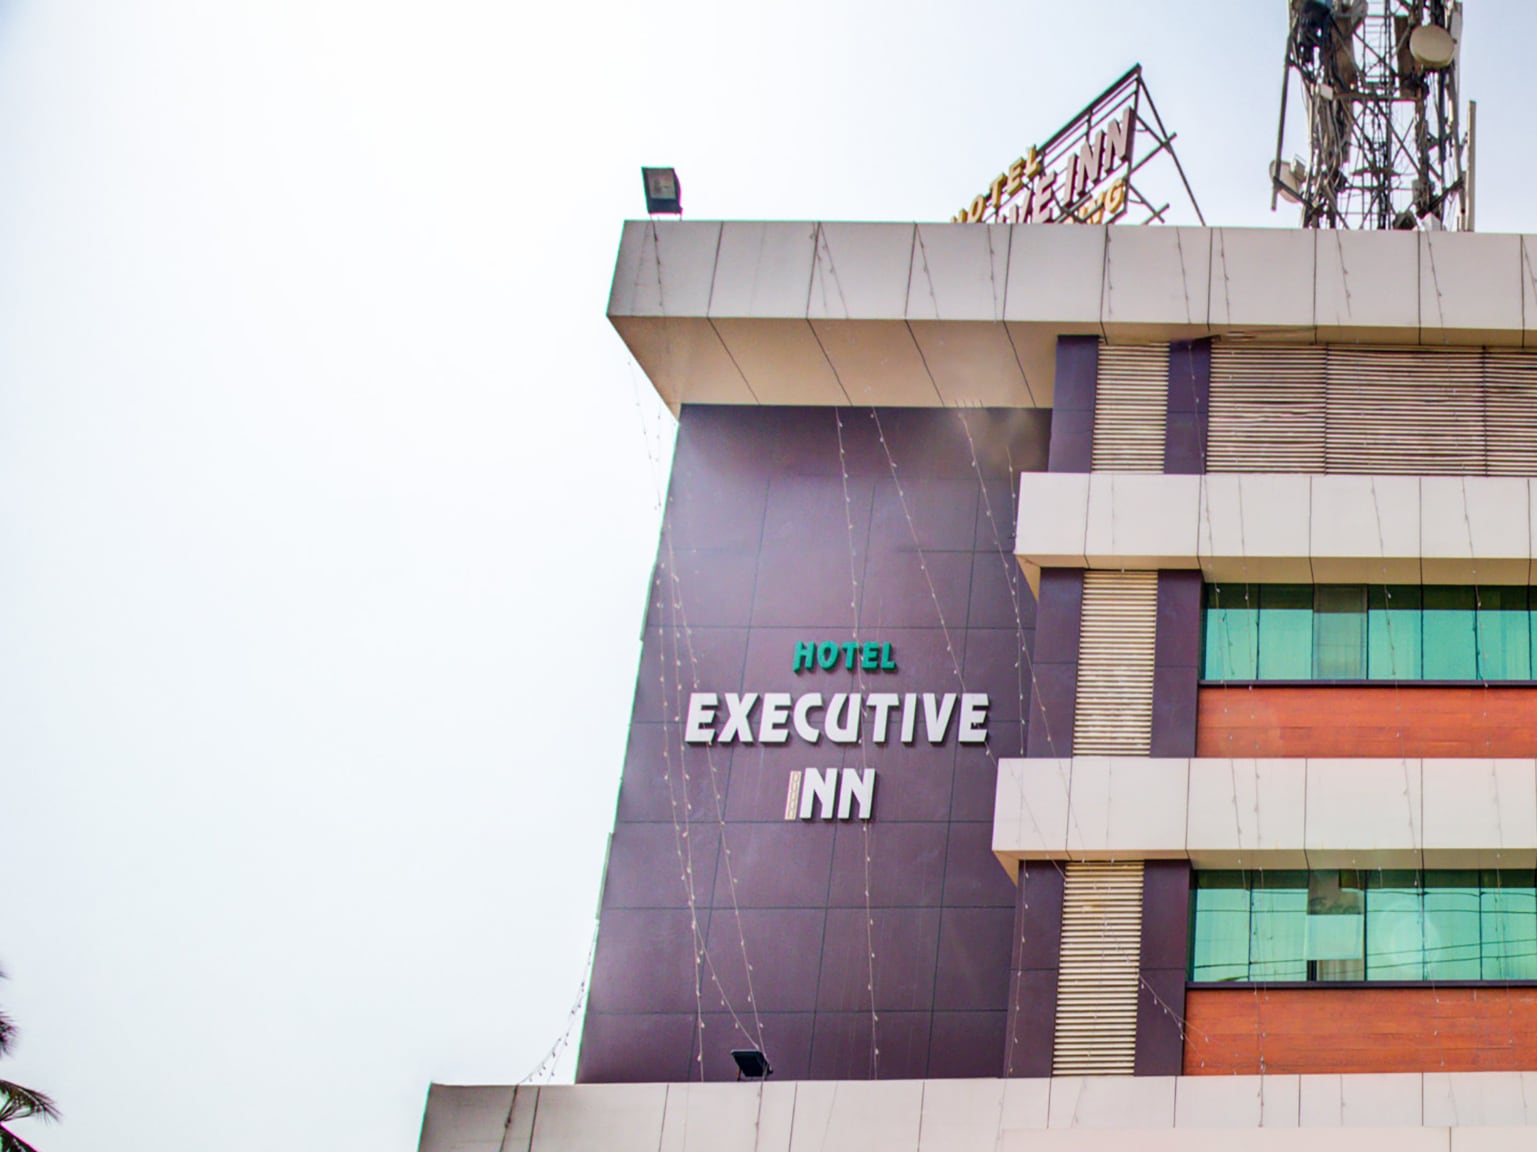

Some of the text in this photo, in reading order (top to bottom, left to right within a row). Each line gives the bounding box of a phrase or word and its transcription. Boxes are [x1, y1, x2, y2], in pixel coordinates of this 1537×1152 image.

[1063, 106, 1134, 211] INN
[793, 641, 897, 674] HOTEL
[685, 692, 989, 744] EXECUTIVE
[784, 767, 876, 821] INN
